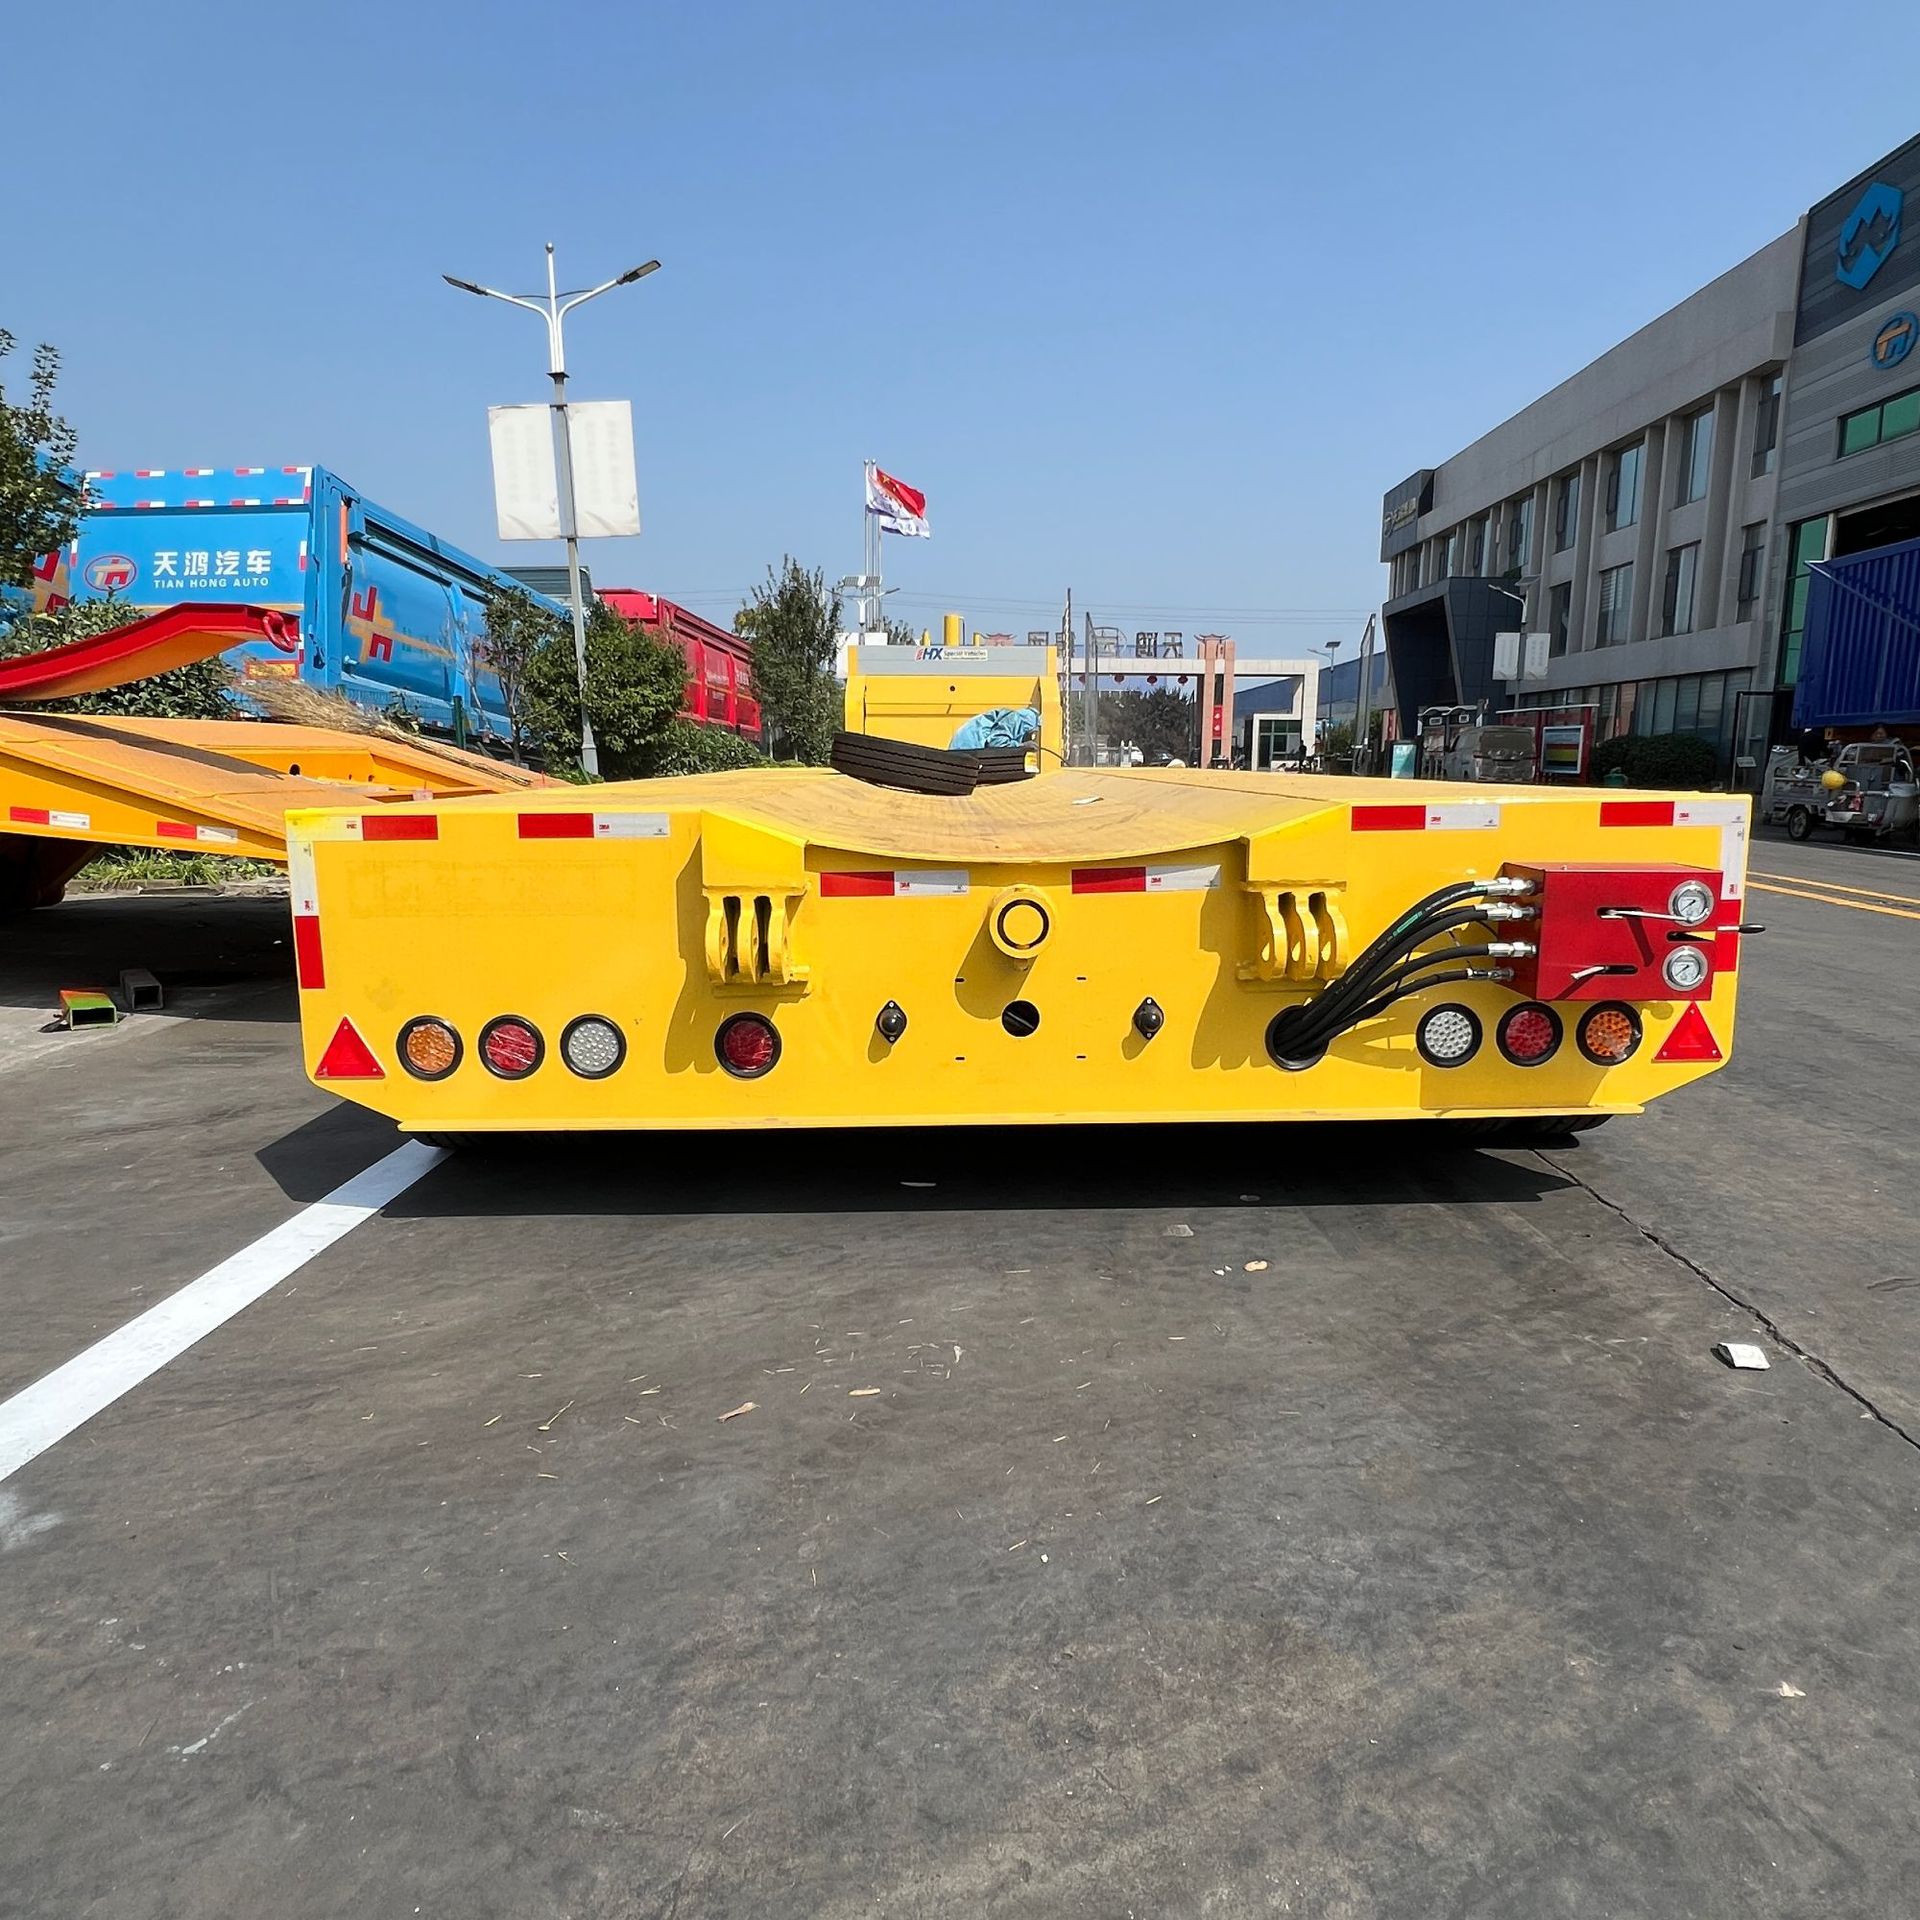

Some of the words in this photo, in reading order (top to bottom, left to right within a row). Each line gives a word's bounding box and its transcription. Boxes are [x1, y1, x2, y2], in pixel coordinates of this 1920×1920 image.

[153, 550, 271, 576] 天鸿汽车
[153, 579, 184, 589] TIAN
[190, 578, 228, 588] HONG
[233, 577, 269, 587] AUTO
